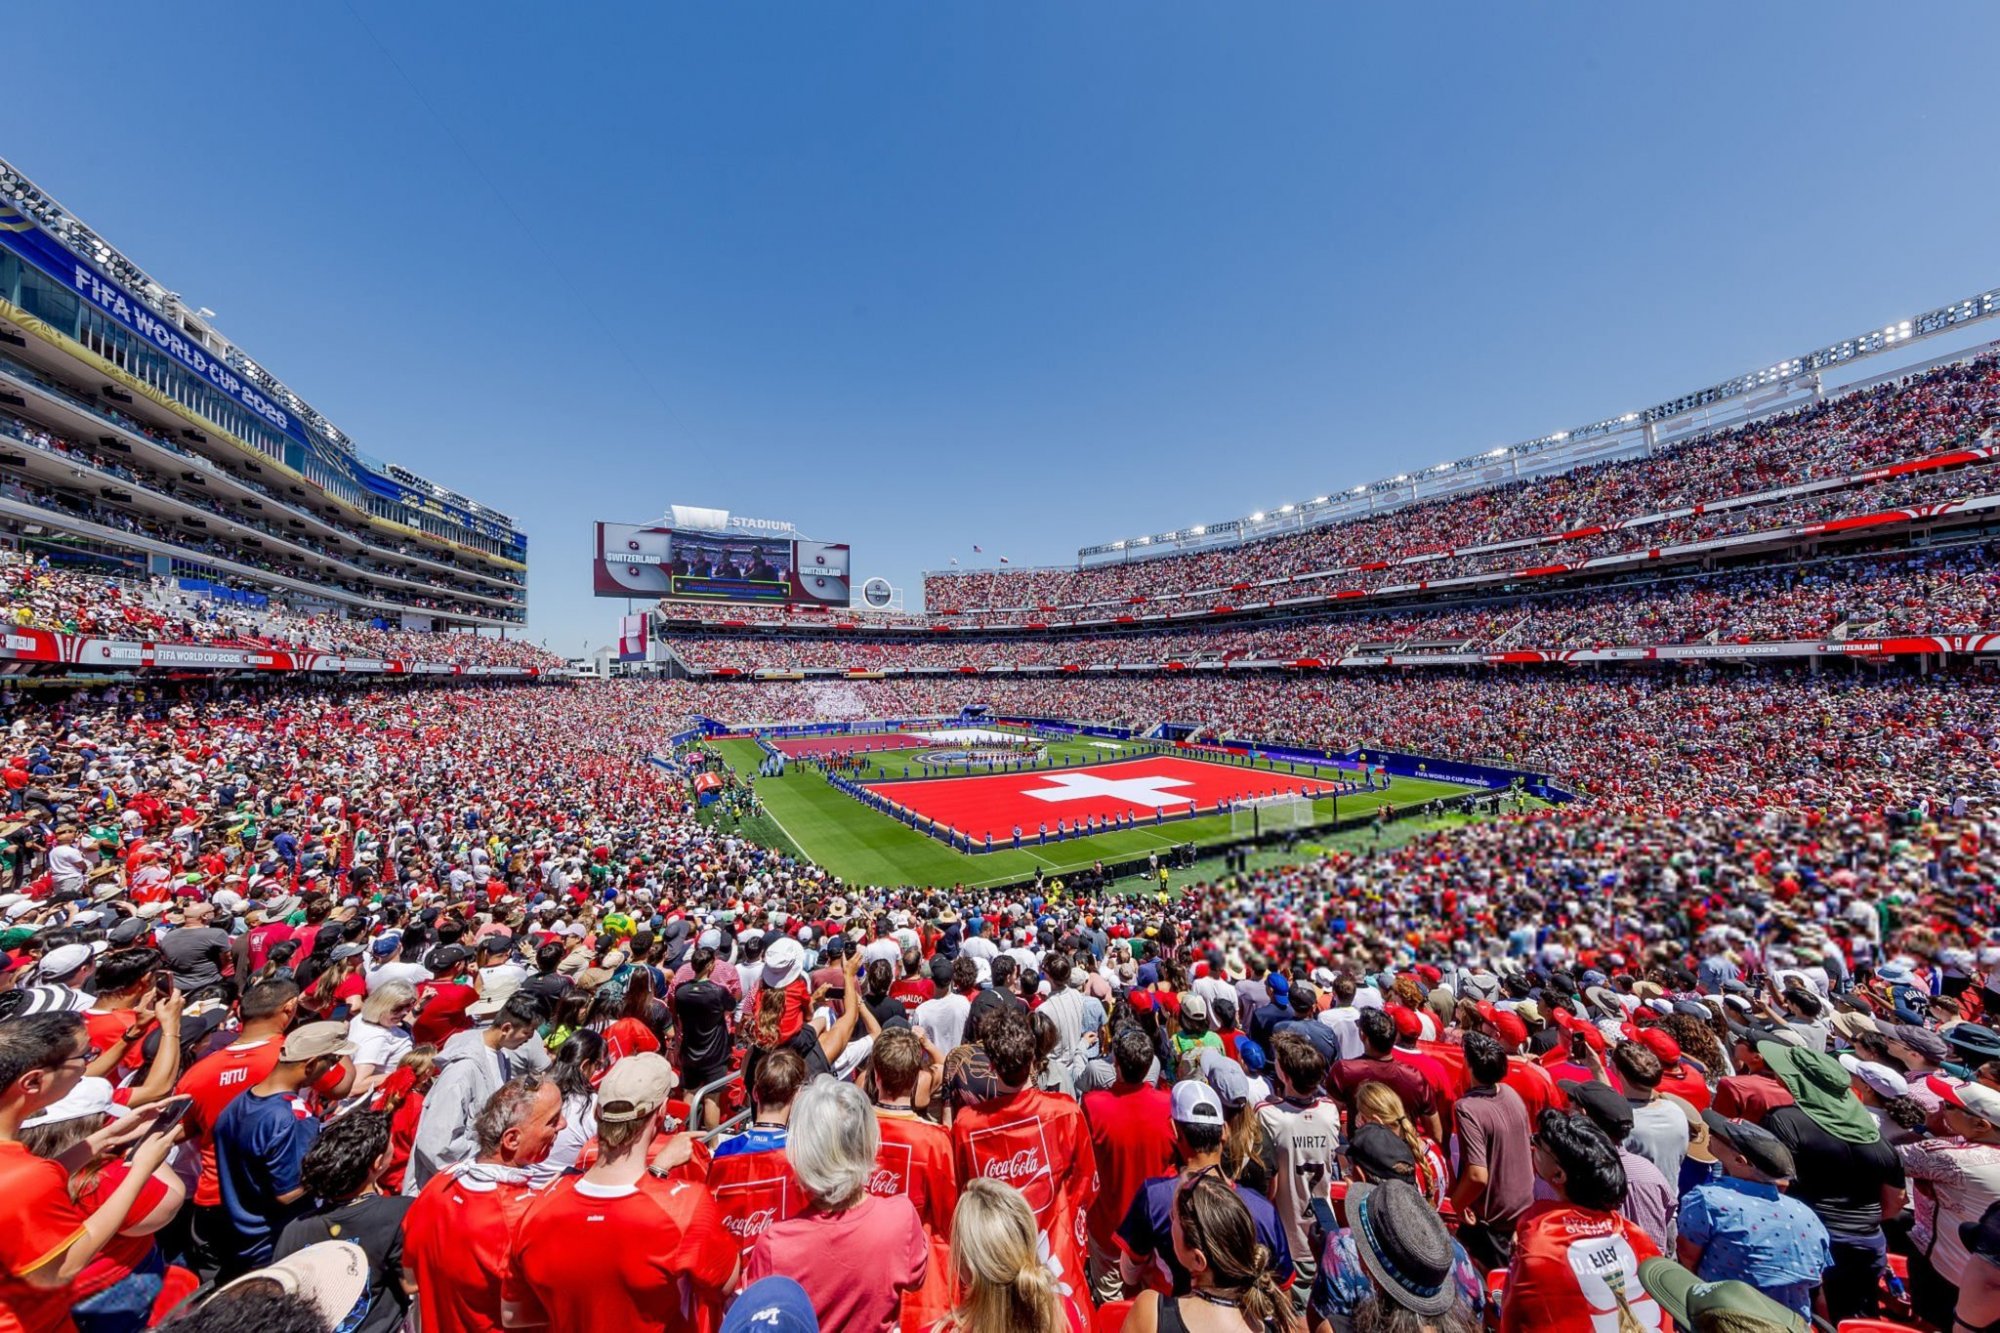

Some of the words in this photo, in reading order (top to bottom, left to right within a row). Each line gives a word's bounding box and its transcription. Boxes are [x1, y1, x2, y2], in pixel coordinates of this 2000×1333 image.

[75, 263, 131, 323] FIFA
[134, 304, 208, 373] WORLD
[208, 362, 241, 395] CUP
[241, 386, 288, 430] 2026
[732, 516, 791, 532] STADIUM
[606, 552, 661, 564] SWITZERLAND
[800, 566, 841, 577] SWITZERLAND
[110, 647, 154, 660] SWITZERLAND
[158, 650, 175, 661] FIFA
[177, 651, 203, 662] WORLD
[204, 653, 217, 662] CUP
[218, 654, 240, 663] 2026
[1428, 773, 1451, 781] WORLD
[219, 1067, 248, 1087] RITU
[1292, 1135, 1326, 1148] WIRTZ
